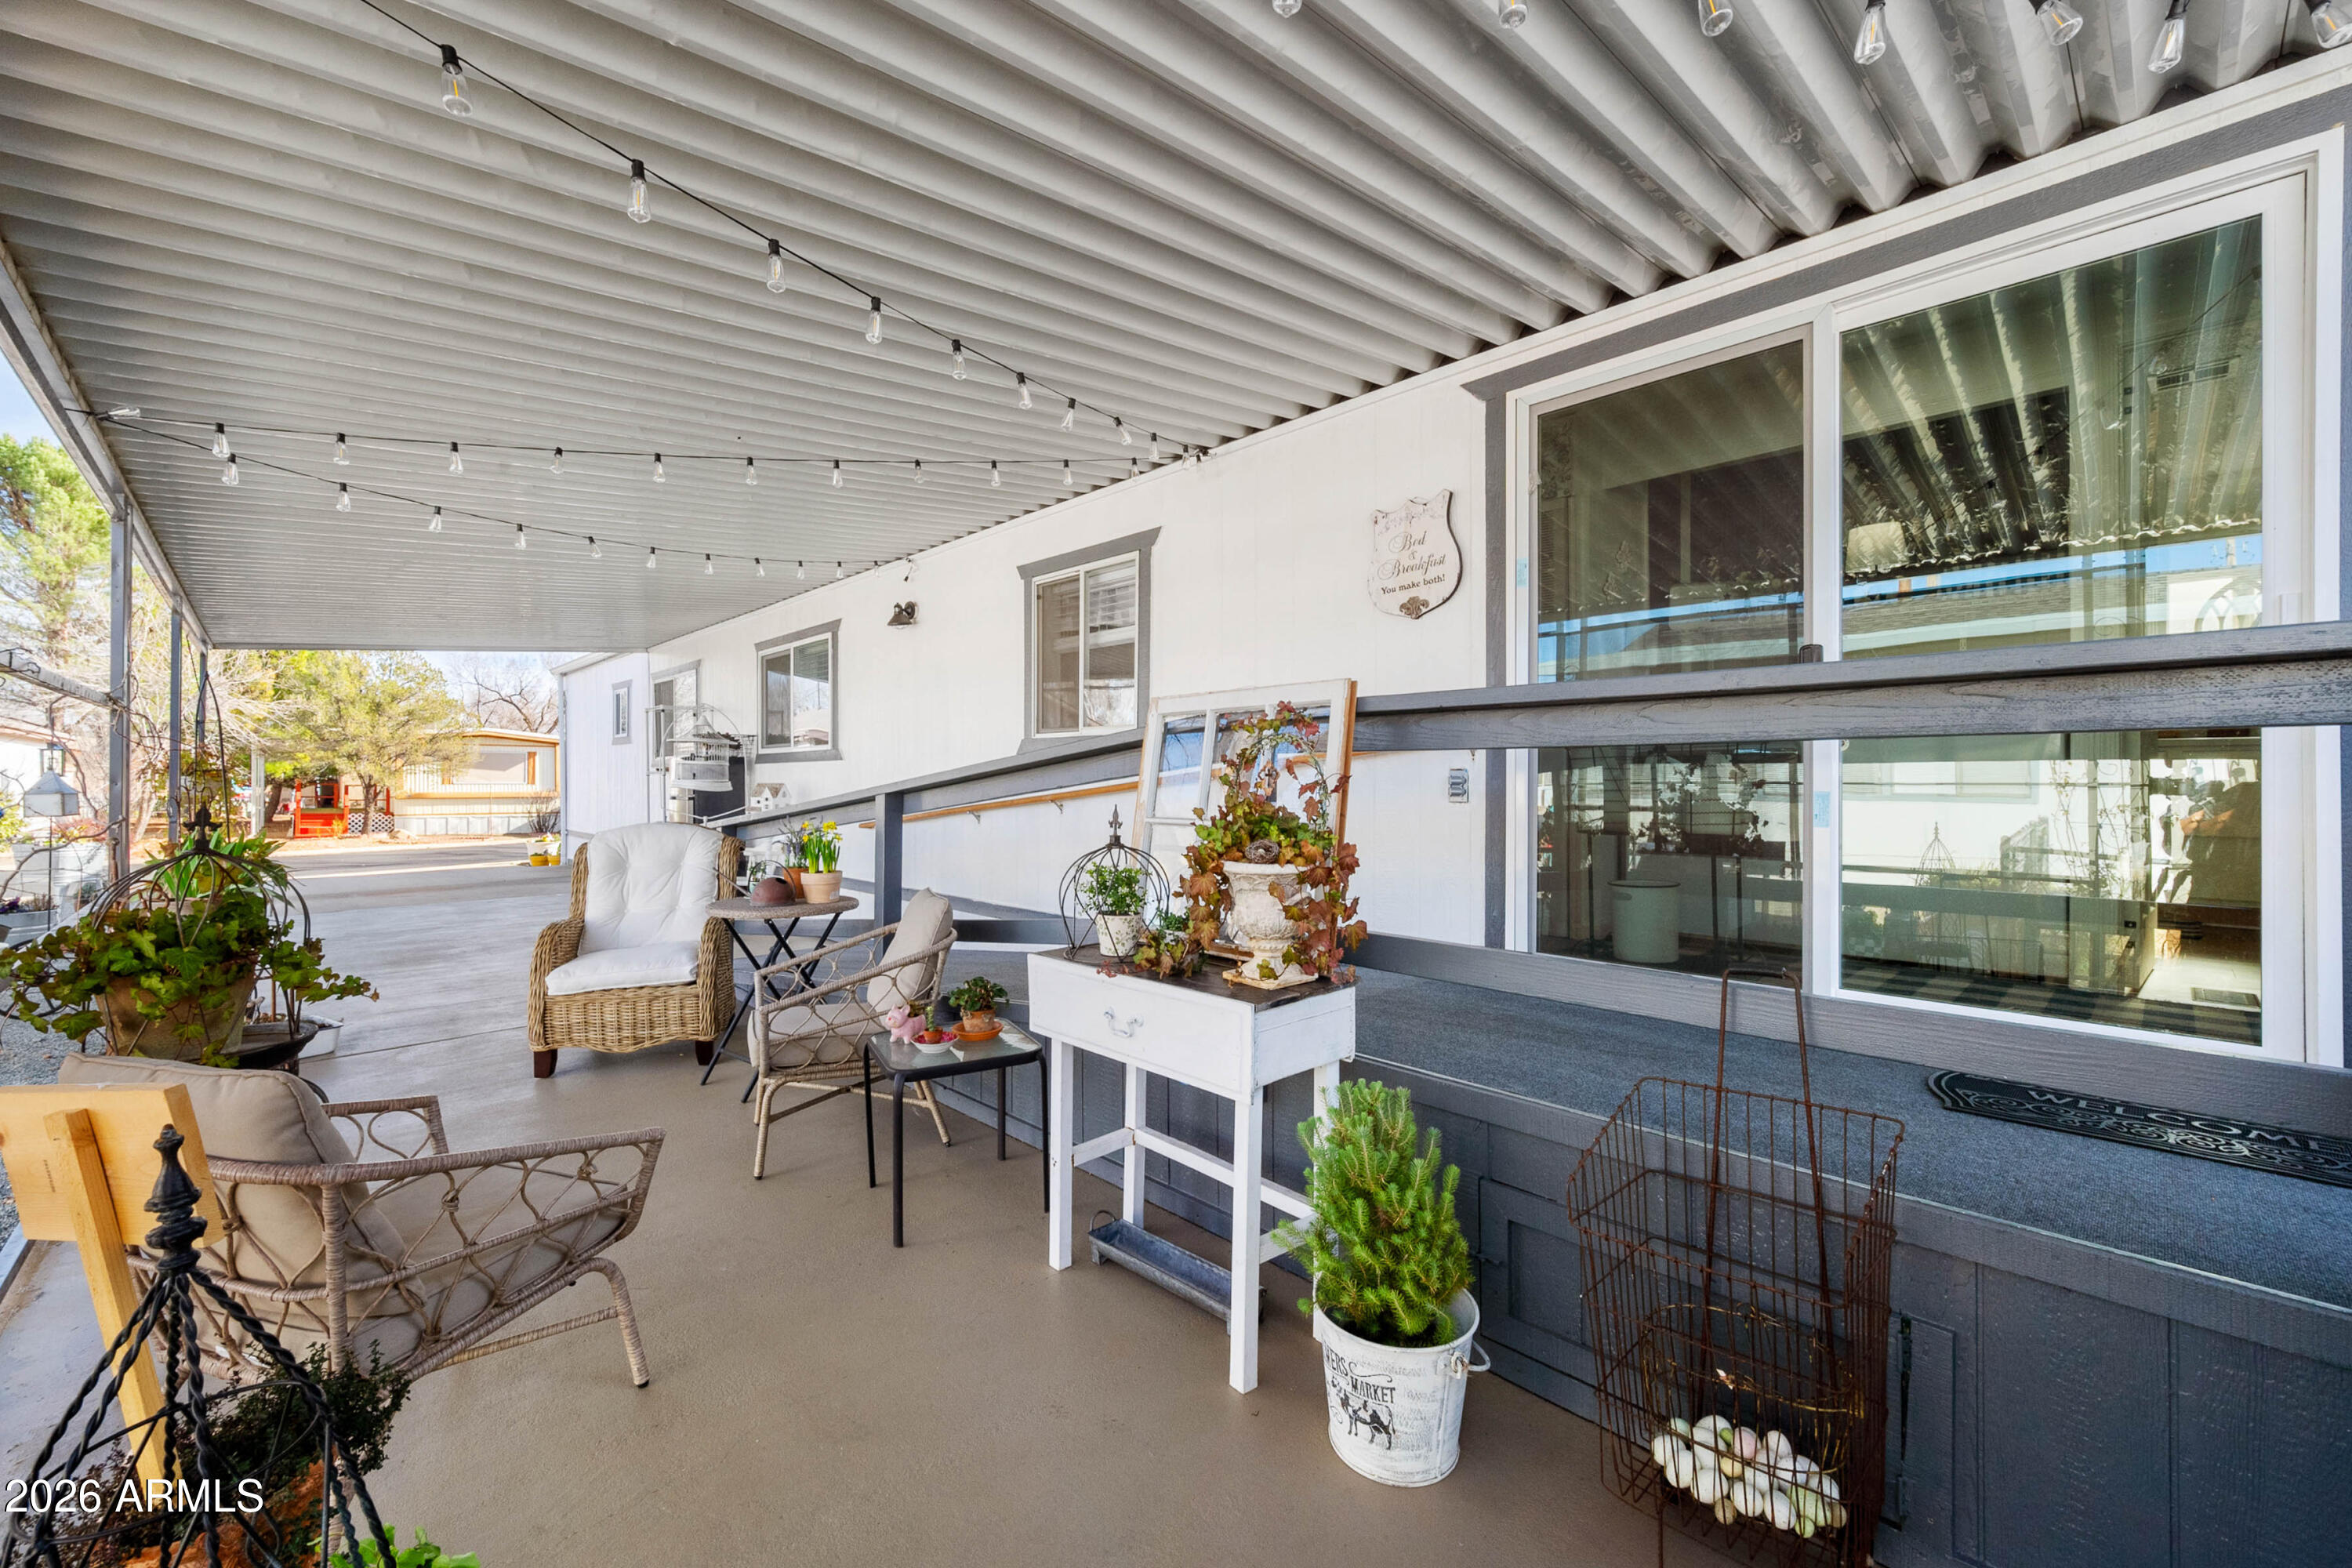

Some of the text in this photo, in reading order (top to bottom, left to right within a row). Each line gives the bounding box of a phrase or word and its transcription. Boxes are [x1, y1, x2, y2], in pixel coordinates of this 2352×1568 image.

[1388, 531, 1427, 553] Bed
[1377, 554, 1446, 580] Breakfast
[1408, 550, 1417, 561] &
[1381, 574, 1446, 595] You make both!
[2027, 1090, 2350, 1157] WELCOME
[1350, 1377, 1396, 1403] MARKET
